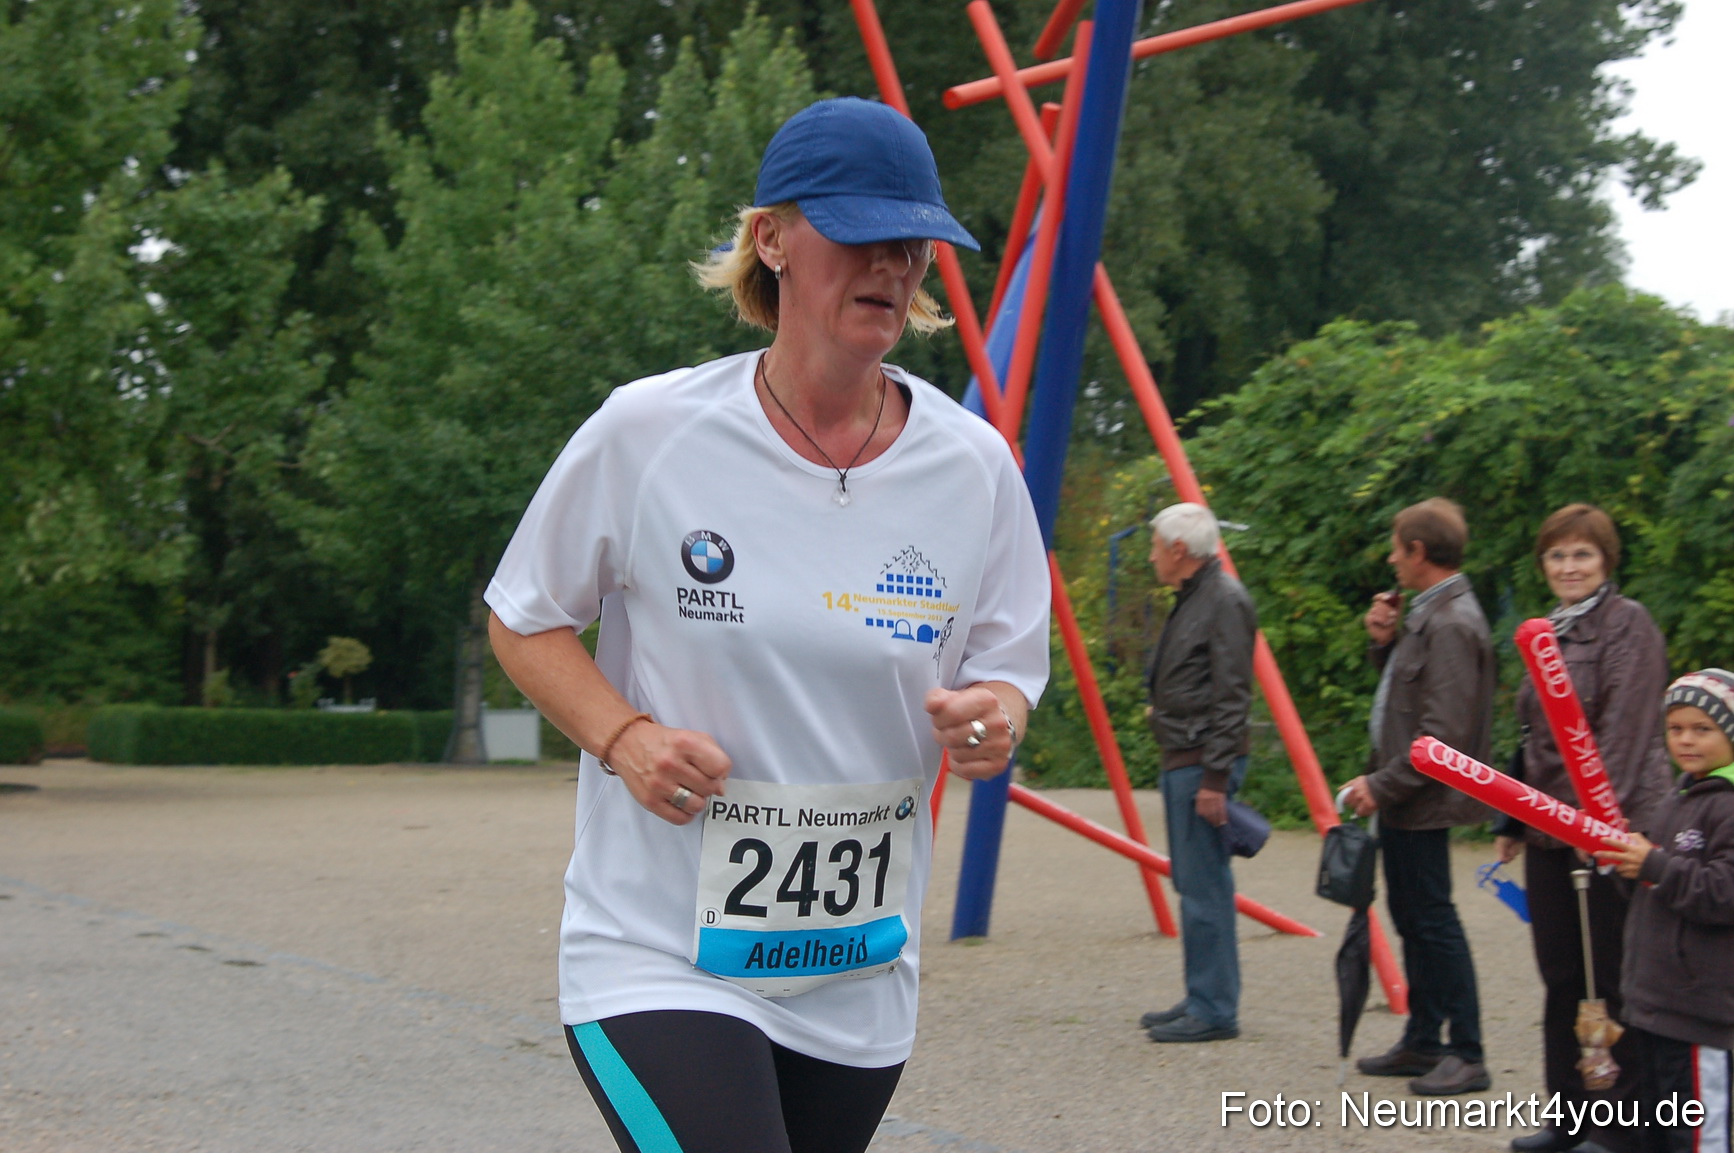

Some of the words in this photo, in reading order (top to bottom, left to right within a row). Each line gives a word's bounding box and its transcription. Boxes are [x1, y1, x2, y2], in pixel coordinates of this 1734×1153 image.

[684, 530, 730, 552] BMW
[676, 586, 744, 610] PARTL
[822, 591, 859, 613] 14.
[853, 593, 917, 608] Neumarkter
[678, 605, 745, 624] Neumarkt
[1563, 717, 1604, 778] BKK
[711, 801, 791, 827] PARTL
[797, 804, 891, 827] Neumarkt
[1517, 785, 1577, 826] BKK
[1581, 816, 1636, 846] udi
[723, 831, 892, 919] 2431
[706, 910, 716, 924] D
[744, 933, 868, 970] Adelheid
